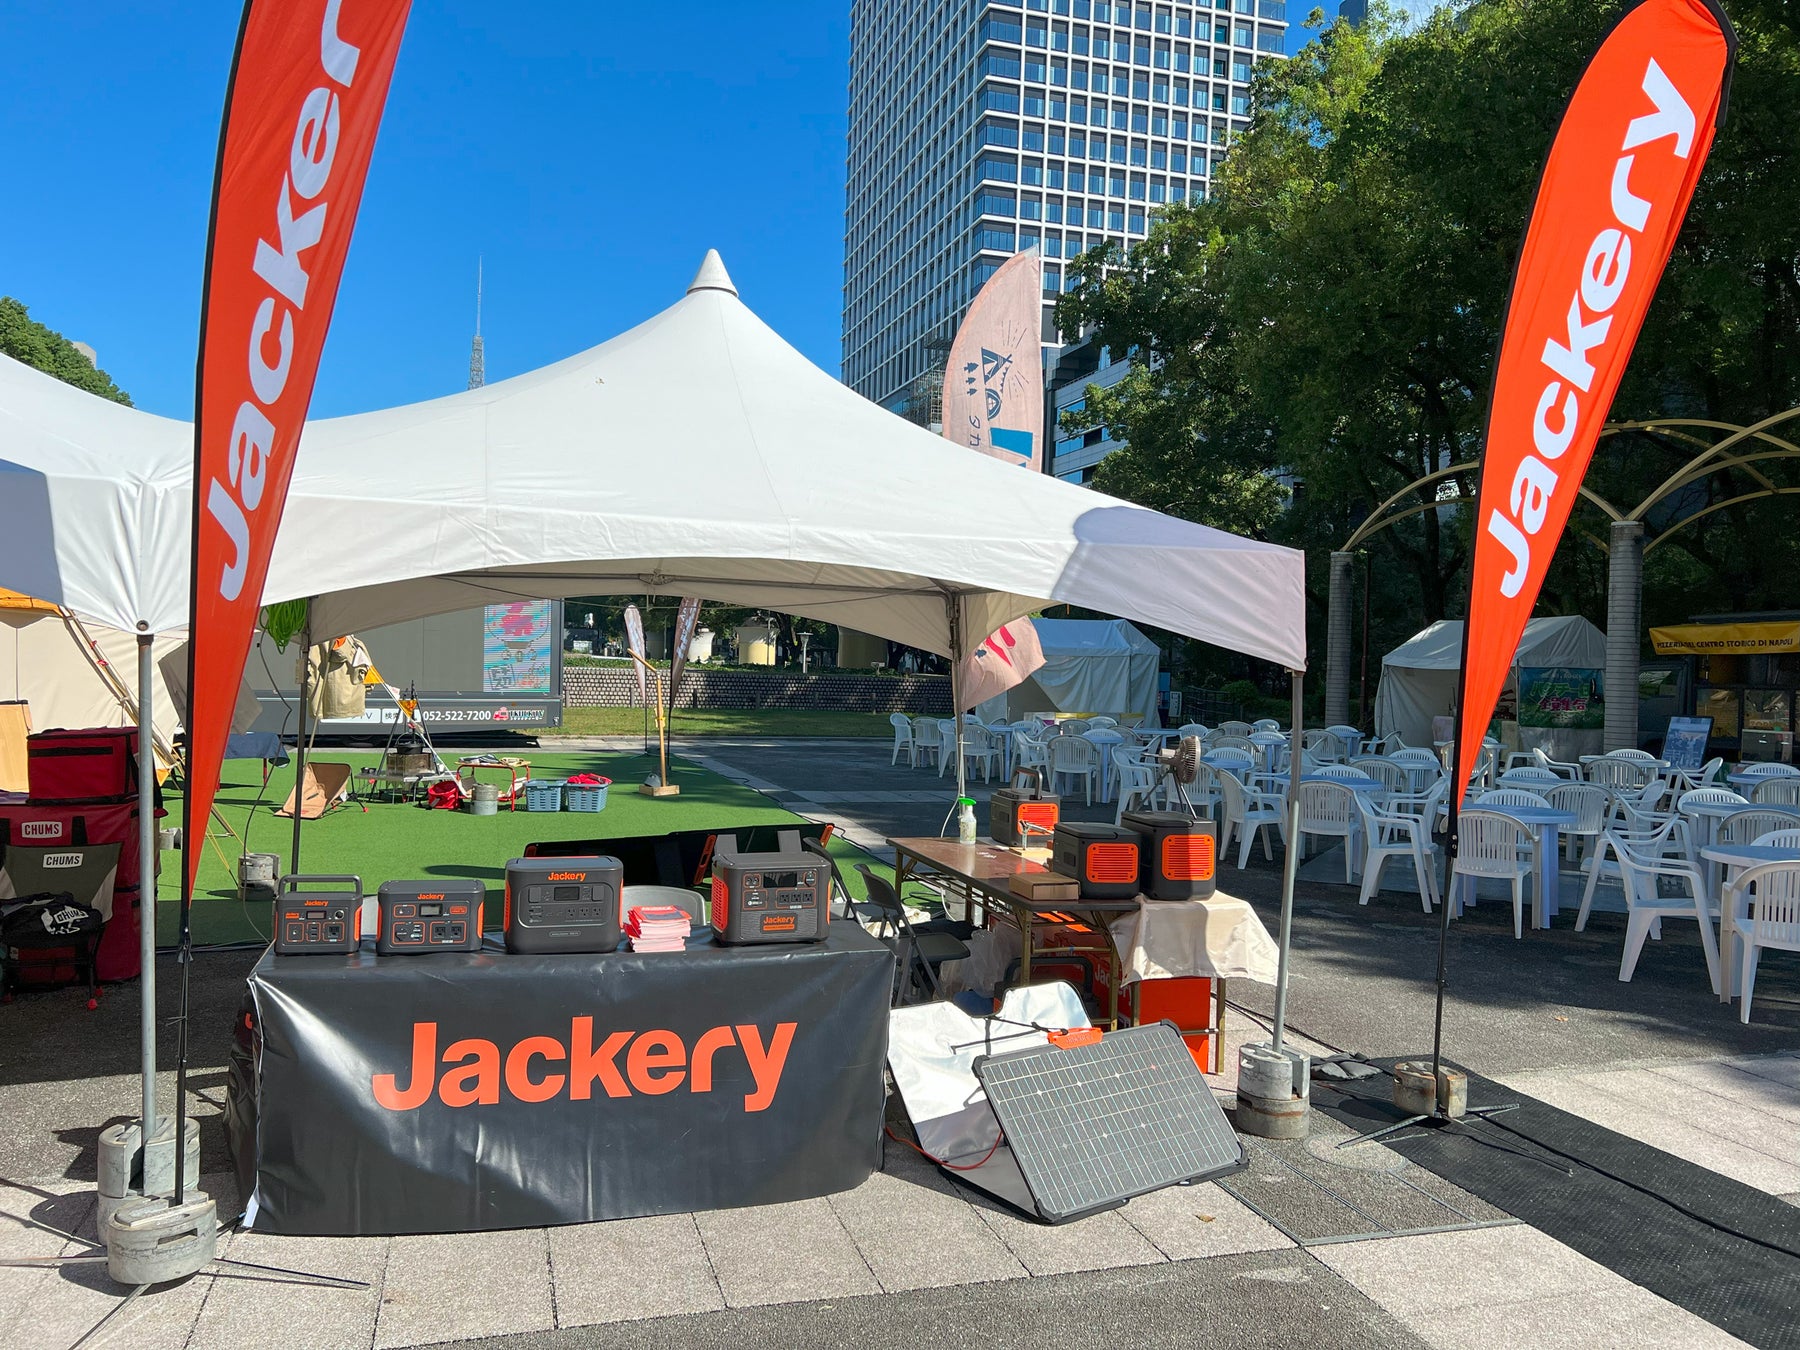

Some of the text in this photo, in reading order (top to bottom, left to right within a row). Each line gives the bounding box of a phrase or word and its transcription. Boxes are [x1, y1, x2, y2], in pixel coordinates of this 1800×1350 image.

[1487, 56, 1696, 599] Jackery
[1727, 640, 1756, 648] STORICO
[1769, 638, 1793, 647] NAPOLI
[423, 710, 491, 721] 052-522-7200
[24, 823, 60, 836] CHUMS
[46, 855, 80, 866] CHUMS
[547, 871, 587, 882] Jackery
[417, 893, 445, 901] Jackery
[56, 909, 87, 922] CHUMS
[763, 915, 796, 925] Jackery
[372, 1015, 798, 1112] Jackery
